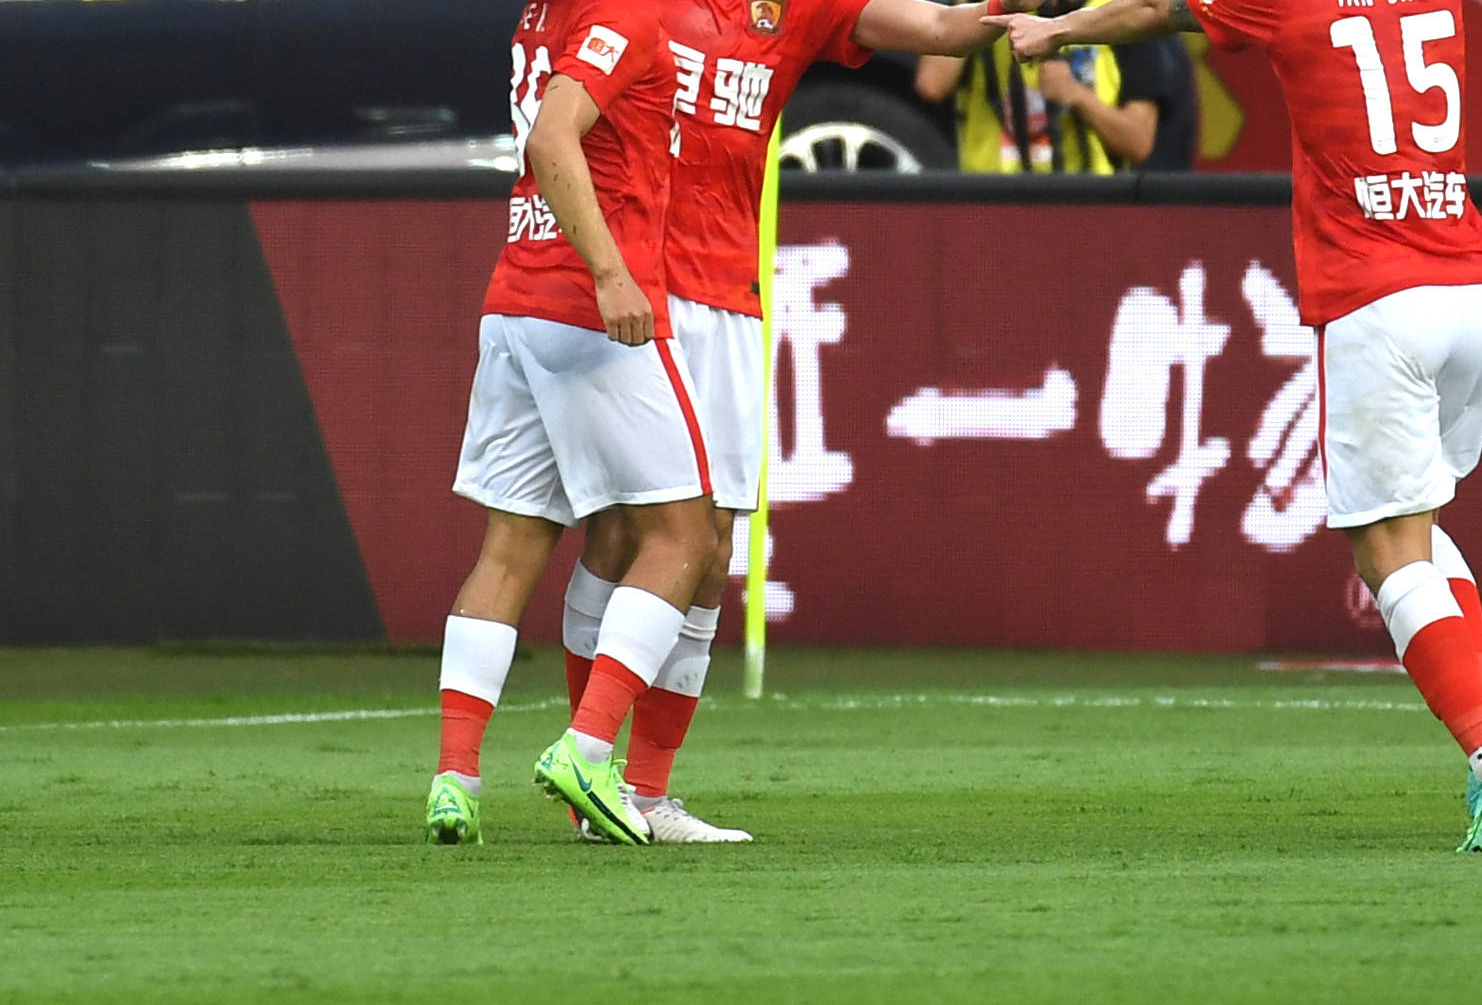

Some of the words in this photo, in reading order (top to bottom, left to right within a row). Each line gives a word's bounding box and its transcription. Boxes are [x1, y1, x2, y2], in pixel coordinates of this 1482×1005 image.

[1330, 9, 1461, 155] 15
[1354, 170, 1466, 220] 恒大汽车
